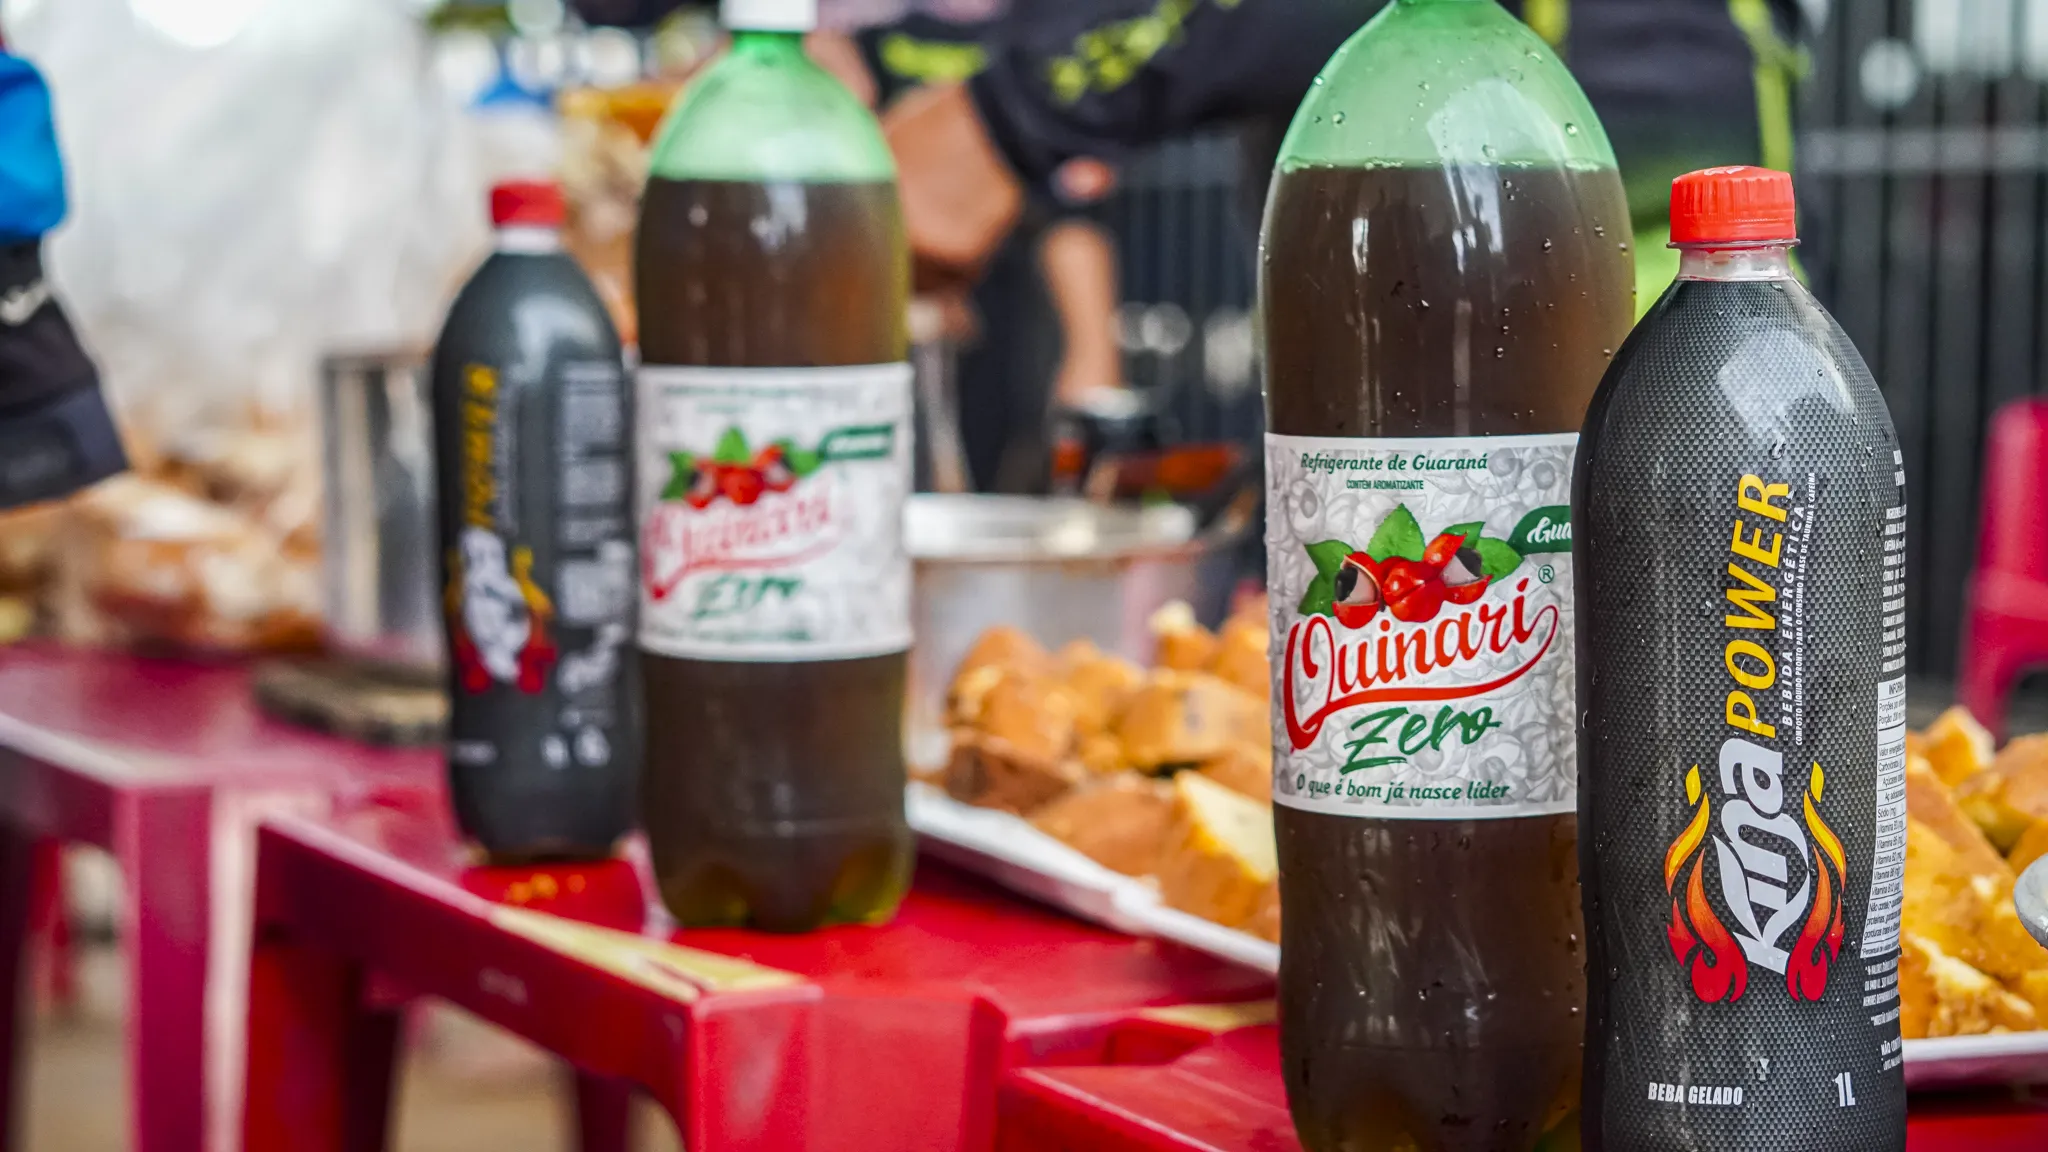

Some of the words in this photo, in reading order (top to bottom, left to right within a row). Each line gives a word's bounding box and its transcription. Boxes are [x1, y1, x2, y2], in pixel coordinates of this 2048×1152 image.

[1300, 453, 1383, 475] Refrigerante
[1387, 454, 1407, 471] de
[1412, 453, 1488, 471] Guaraná
[1373, 480, 1424, 490] AROMATIZANTE
[1806, 472, 1816, 502] CAFEÍNA
[1802, 510, 1814, 542] TAURINA
[1798, 553, 1807, 573] BASE
[1800, 544, 1808, 553] DE
[1781, 506, 1805, 640] ENERGÉTICA
[1724, 473, 1789, 739] POWER
[1795, 582, 1804, 618] CONSUMO
[1795, 627, 1804, 646] PARA
[1283, 577, 1559, 755] Quinari
[1795, 647, 1803, 676] PRONTO
[1781, 651, 1793, 727] BEBIDA
[1793, 677, 1803, 707] LÍQUIDO
[1795, 707, 1803, 746] COMPOSTO
[1296, 773, 1306, 791] O
[1308, 780, 1331, 798] que
[1334, 777, 1343, 796] é
[1347, 779, 1382, 798] bom
[1383, 779, 1404, 804] já
[1409, 783, 1462, 800] nasce
[1466, 779, 1510, 800] líder
[1648, 1082, 1684, 1103] BEBA
[1688, 1085, 1743, 1105] GELADO
[1833, 1072, 1856, 1107] 1L
